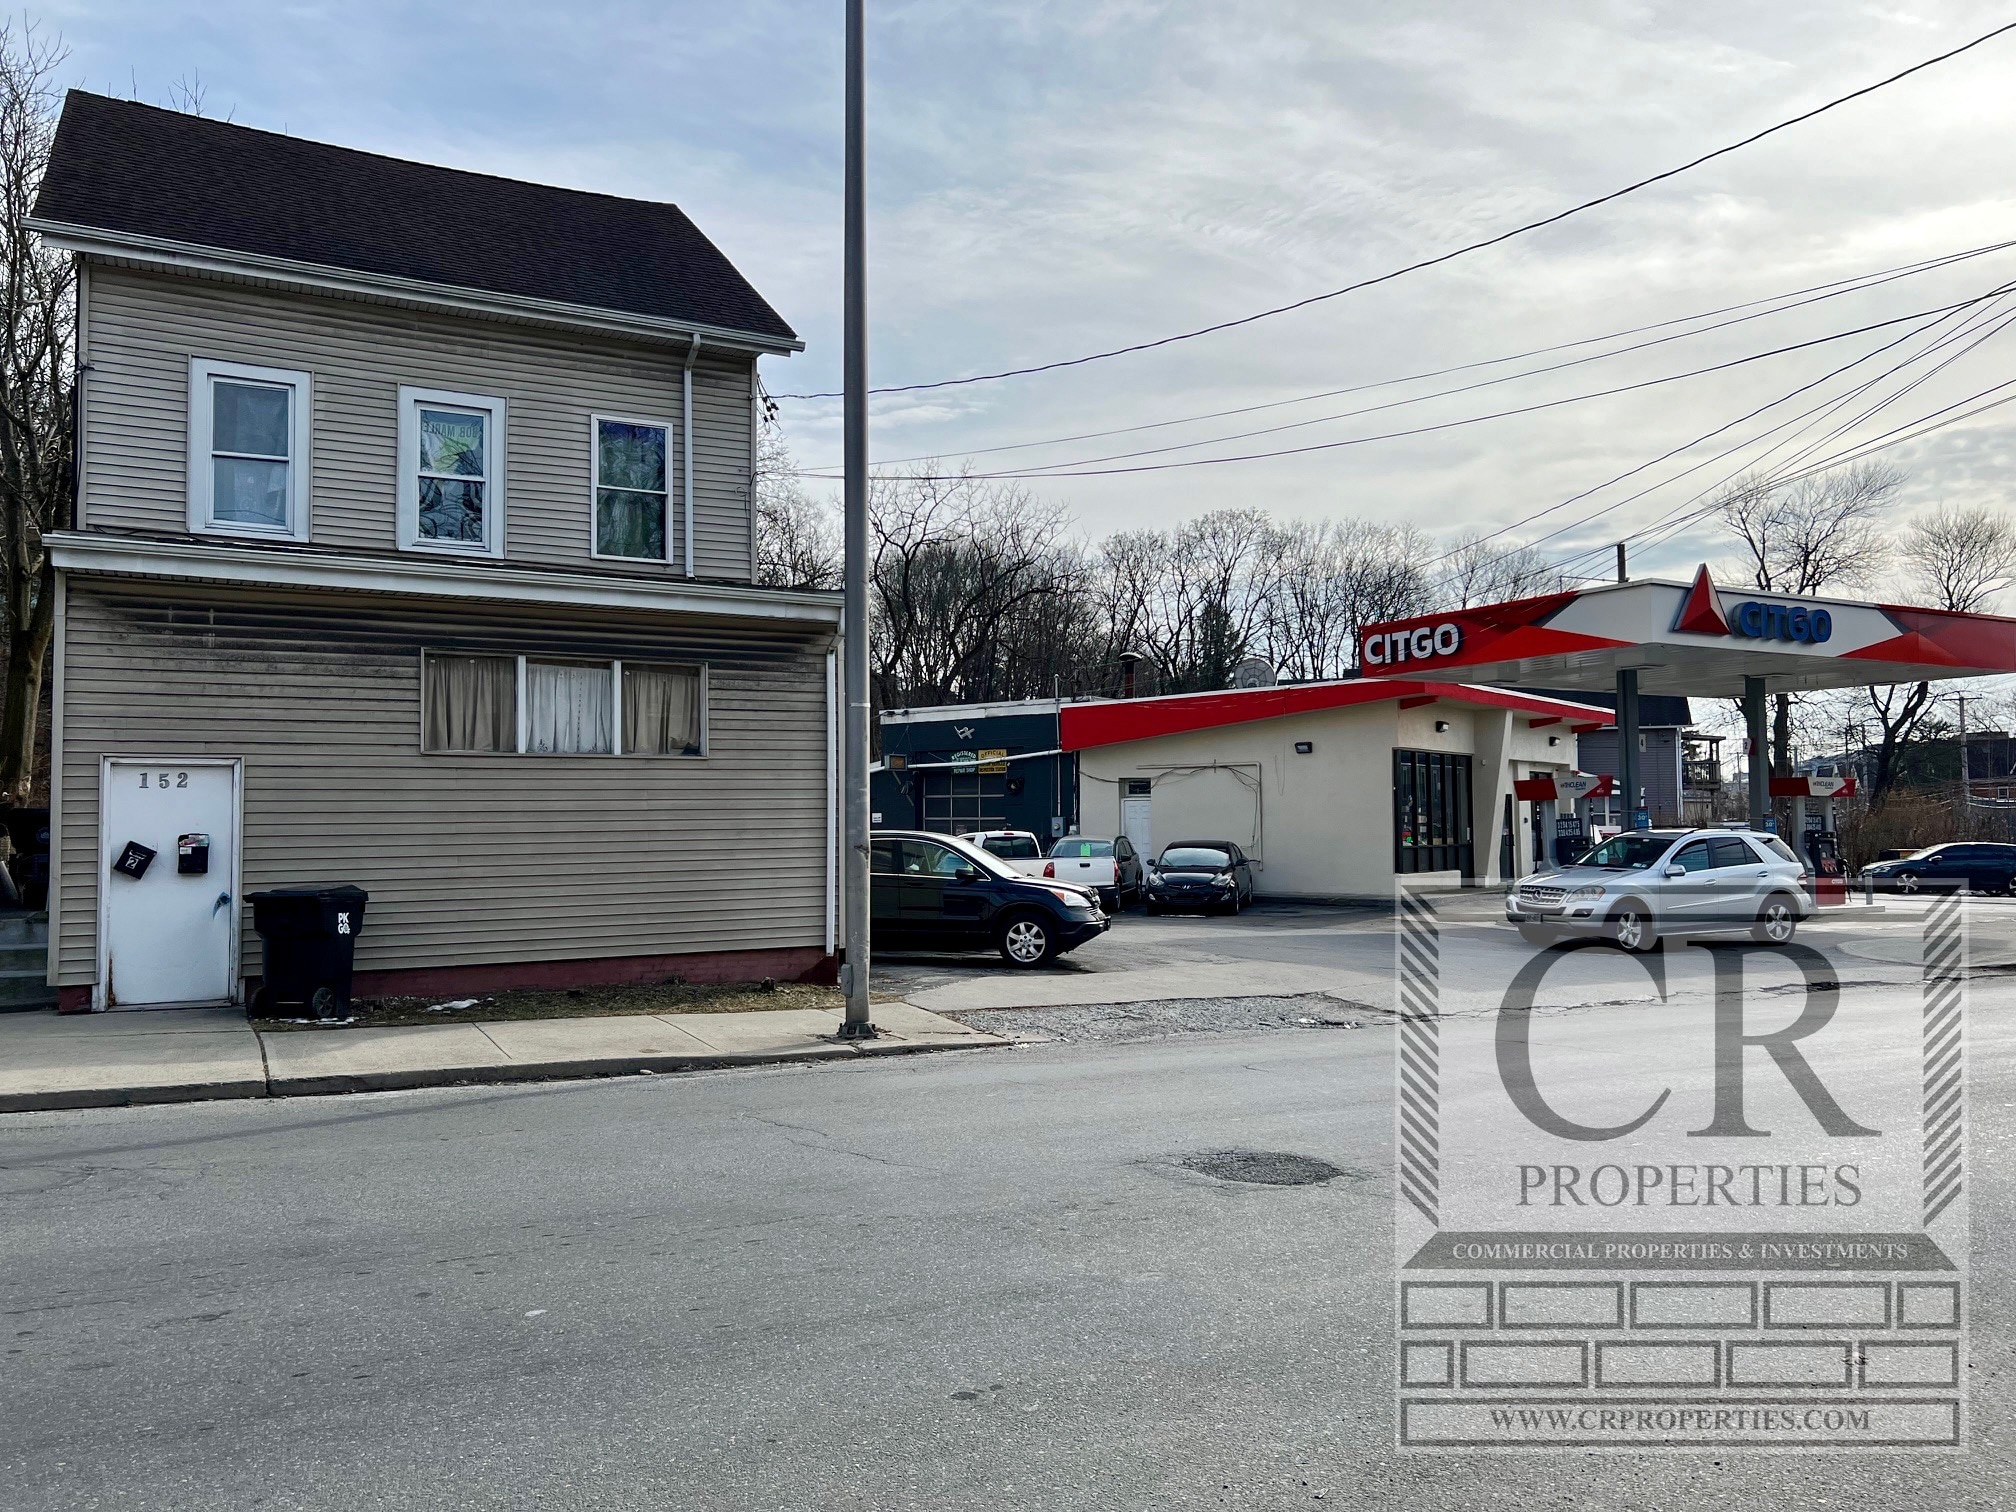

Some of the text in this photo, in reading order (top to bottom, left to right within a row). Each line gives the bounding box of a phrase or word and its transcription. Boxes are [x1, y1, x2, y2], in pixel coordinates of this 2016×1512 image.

[1736, 601, 1832, 643] CITGO
[1364, 623, 1459, 665] CITGO
[981, 750, 1004, 759] OFFICIAL
[139, 772, 188, 789] 152
[338, 912, 350, 923] PK
